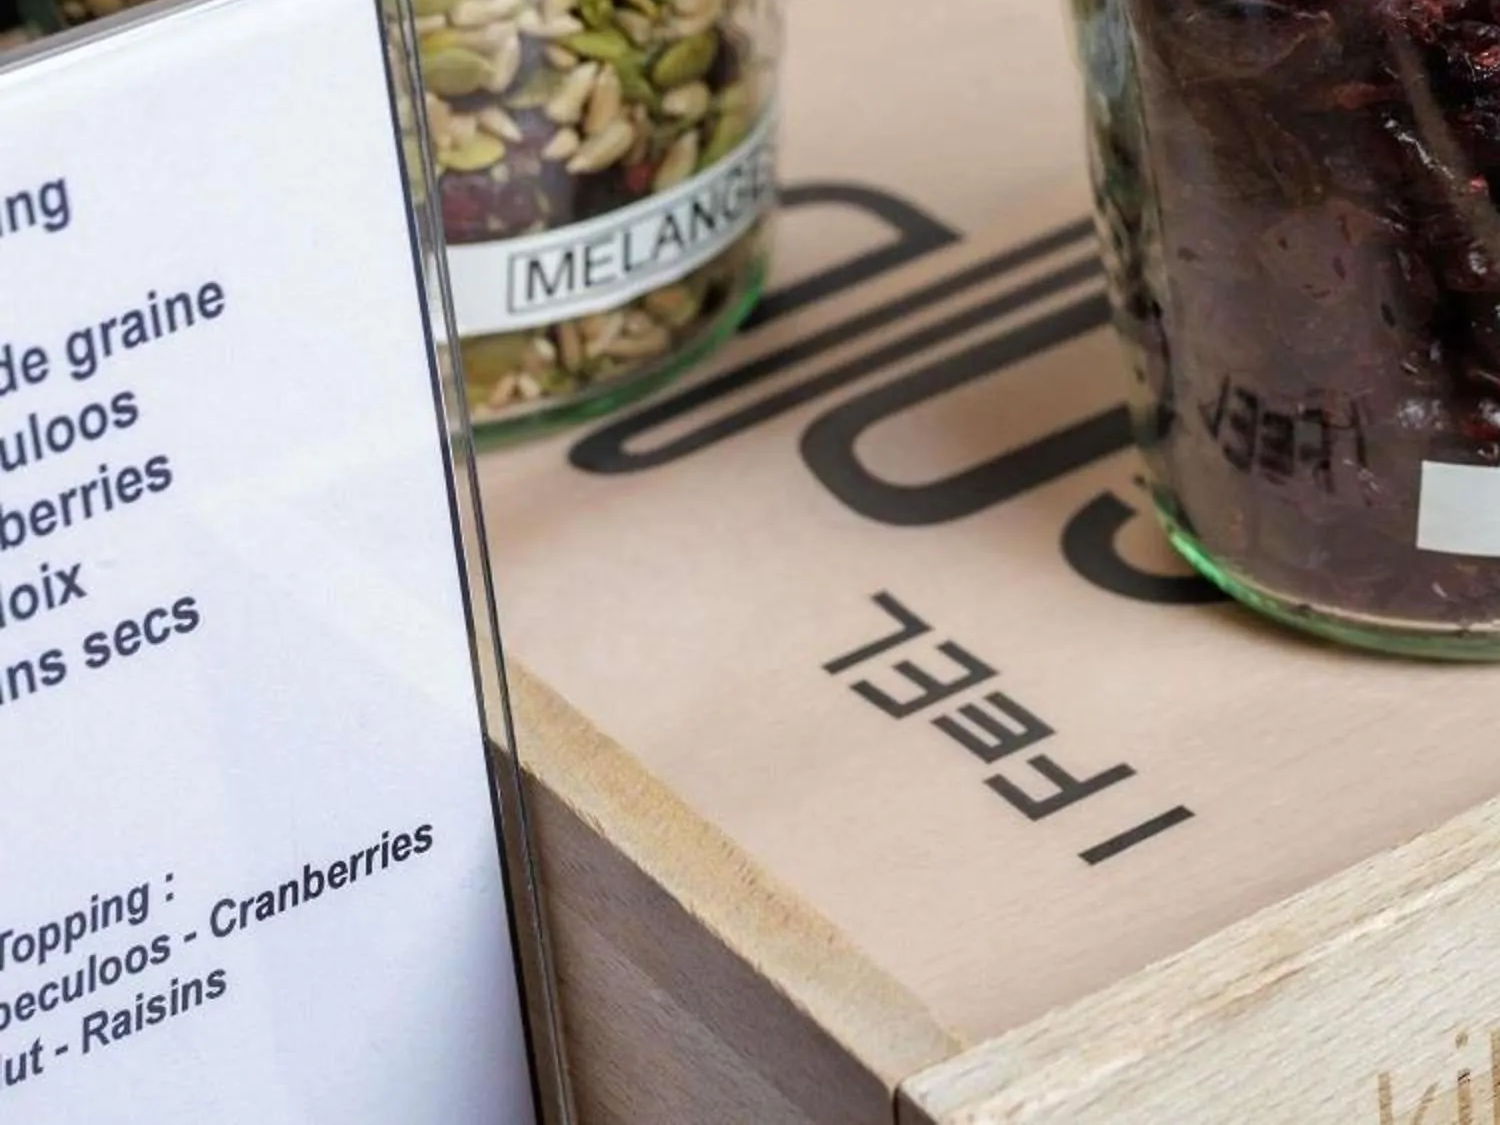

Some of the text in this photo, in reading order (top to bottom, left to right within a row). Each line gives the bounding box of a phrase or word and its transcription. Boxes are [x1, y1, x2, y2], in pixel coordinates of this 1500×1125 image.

[0, 177, 70, 237] ng
[66, 280, 225, 381] graine
[0, 391, 139, 473] uloos
[0, 455, 173, 551] berries
[0, 596, 201, 706] ns secs
[821, 590, 1138, 821] FEEL
[210, 822, 434, 938] Cranberries
[0, 1037, 44, 1087] ut
[81, 969, 227, 1054] Raisins
